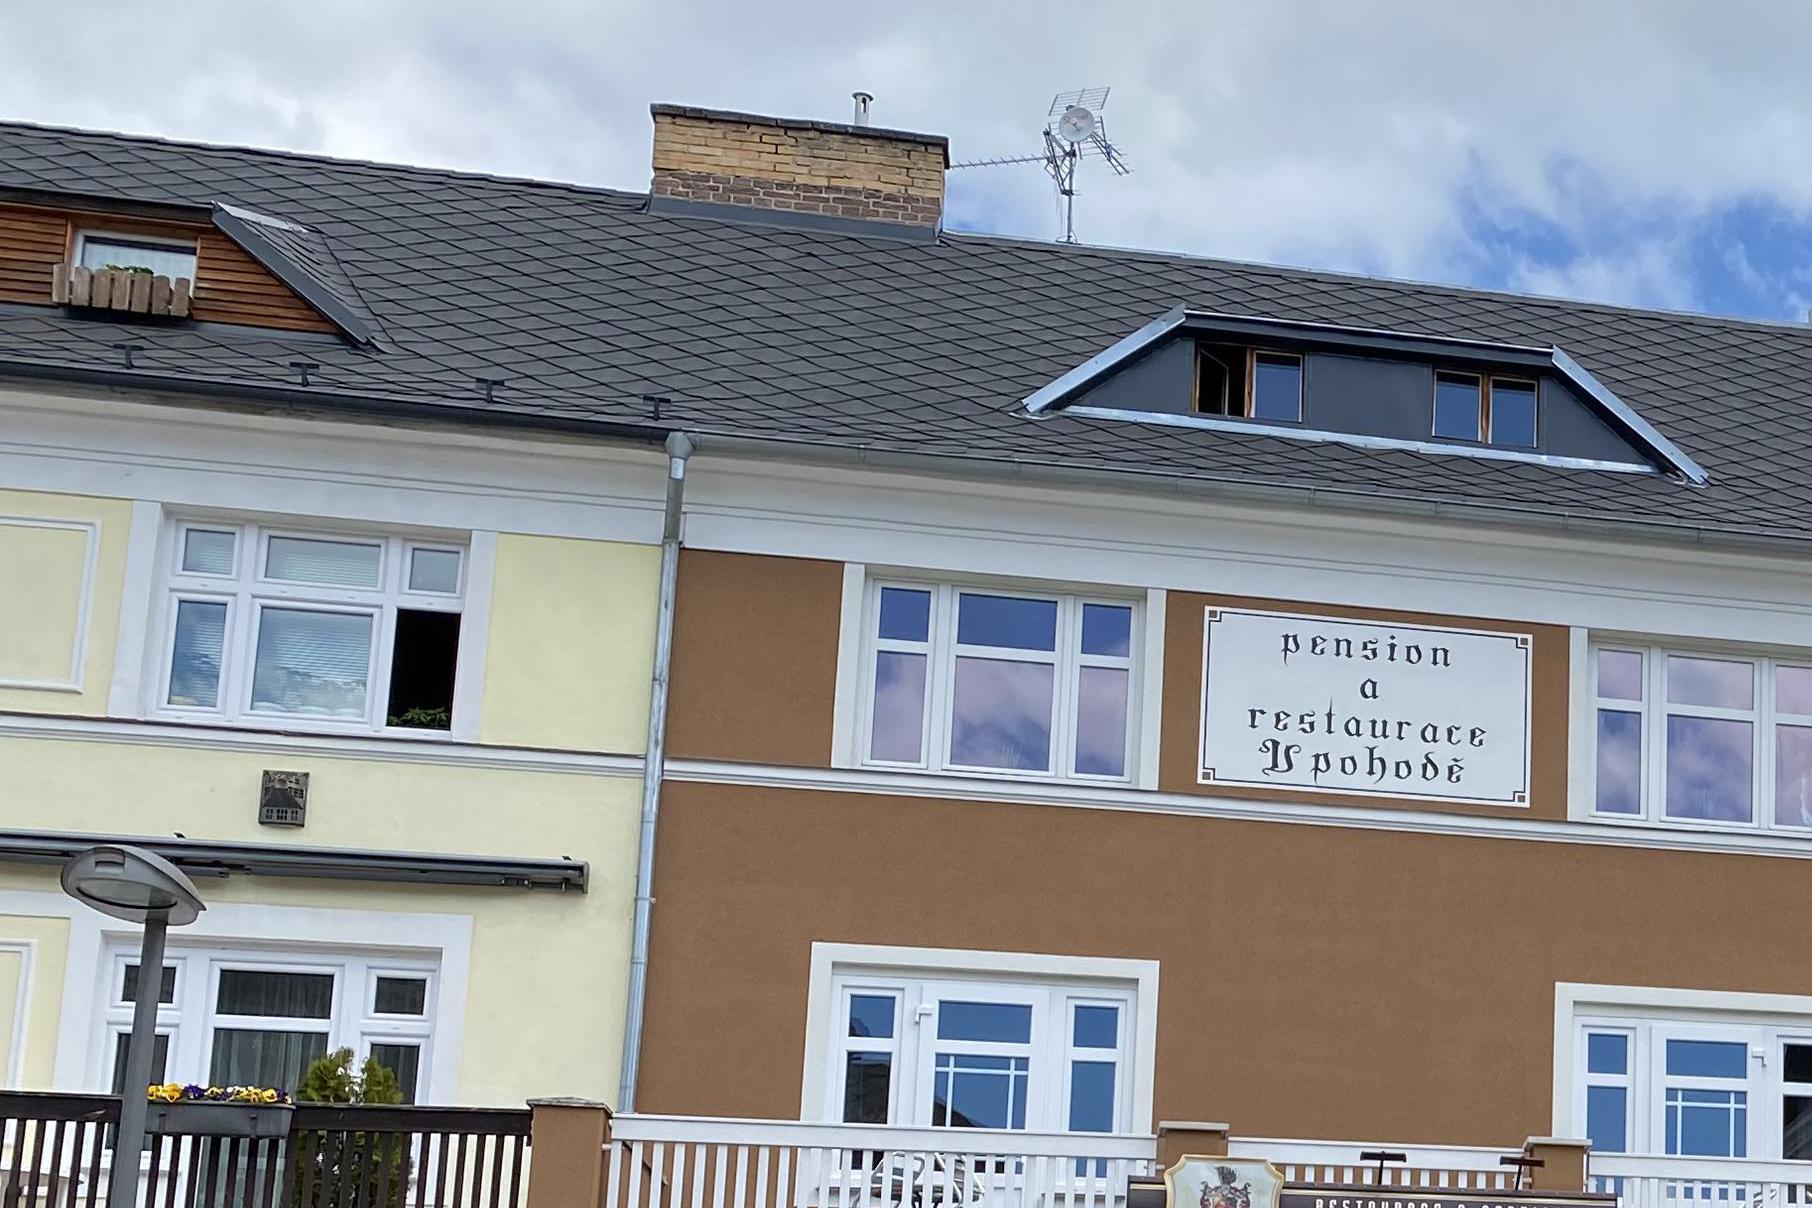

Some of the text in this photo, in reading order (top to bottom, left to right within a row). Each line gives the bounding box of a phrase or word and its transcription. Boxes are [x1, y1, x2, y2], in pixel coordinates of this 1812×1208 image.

[1281, 632, 1451, 668] pension
[1360, 678, 1378, 700] a
[1248, 696, 1487, 748] restaurace
[1258, 738, 1465, 784] V pohodě
